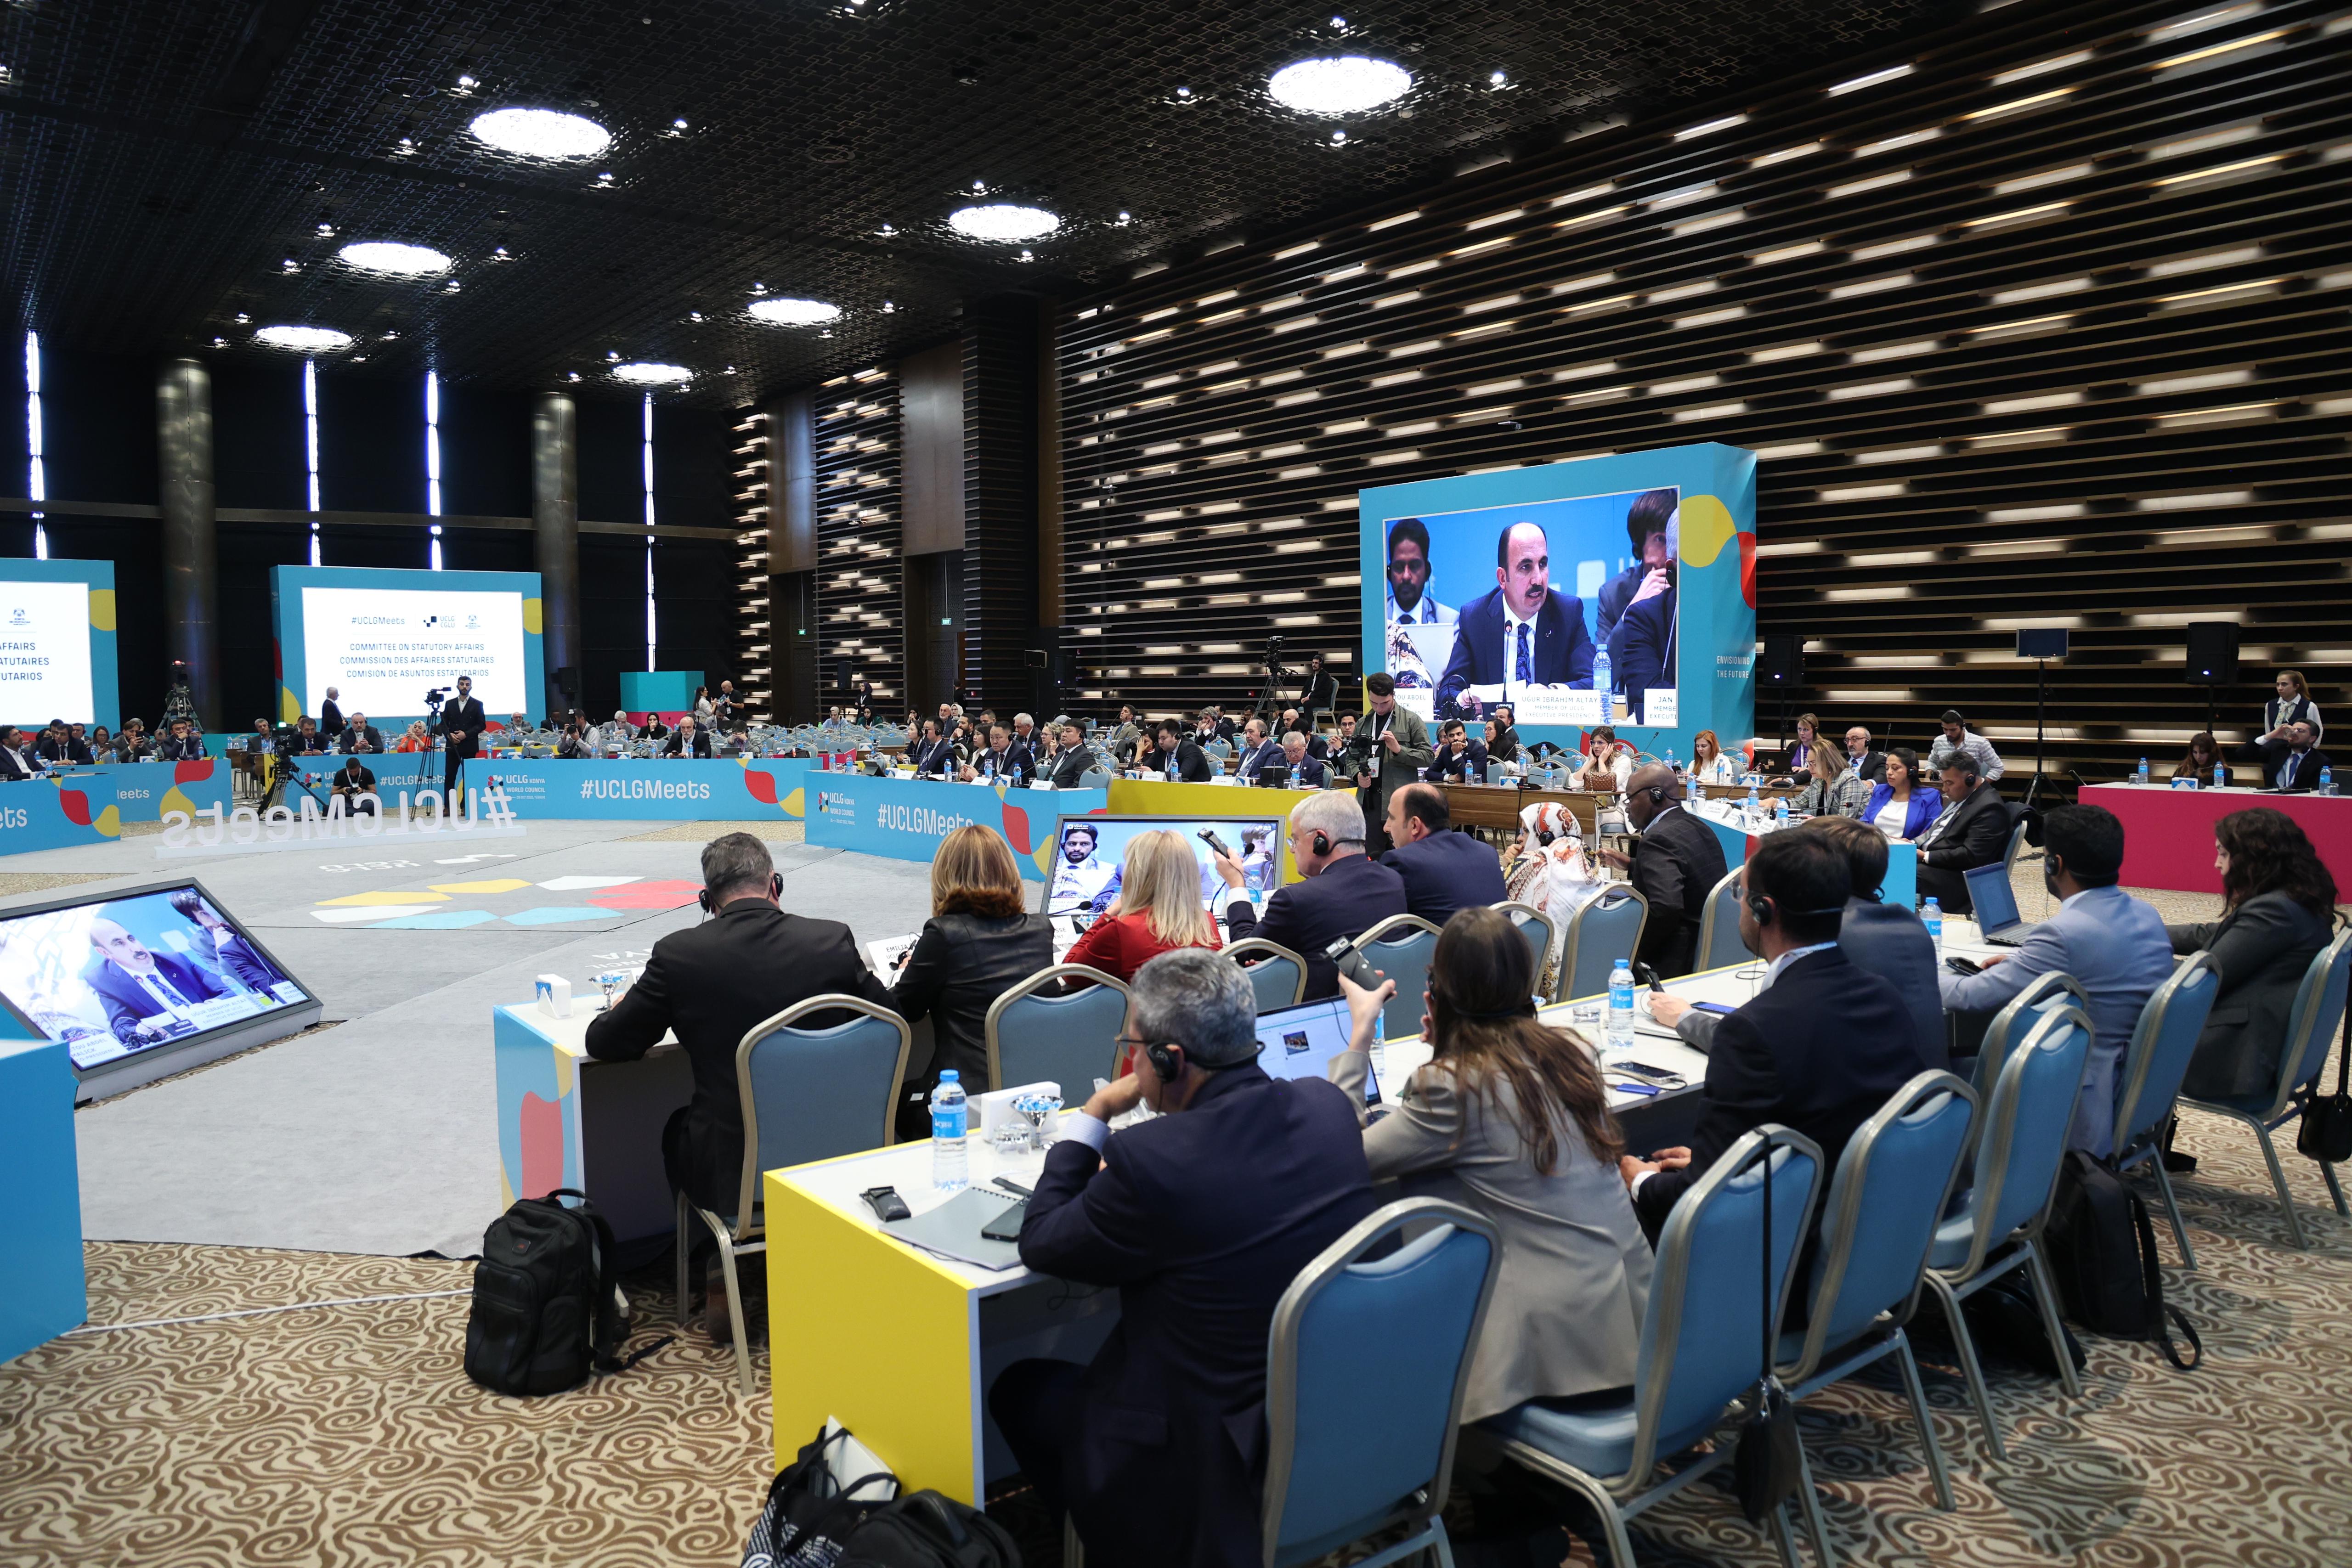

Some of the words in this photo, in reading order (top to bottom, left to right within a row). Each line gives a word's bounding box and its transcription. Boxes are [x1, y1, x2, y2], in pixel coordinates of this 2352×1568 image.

[1717, 655, 1750, 665] ENVISIONING
[1728, 670, 1749, 678] FUTURE
[379, 774, 446, 786] #UCLGMeet
[506, 774, 528, 784] UCLG
[117, 789, 150, 799] eets
[580, 779, 710, 799] #UCLGMeets
[830, 792, 844, 804] UCLG
